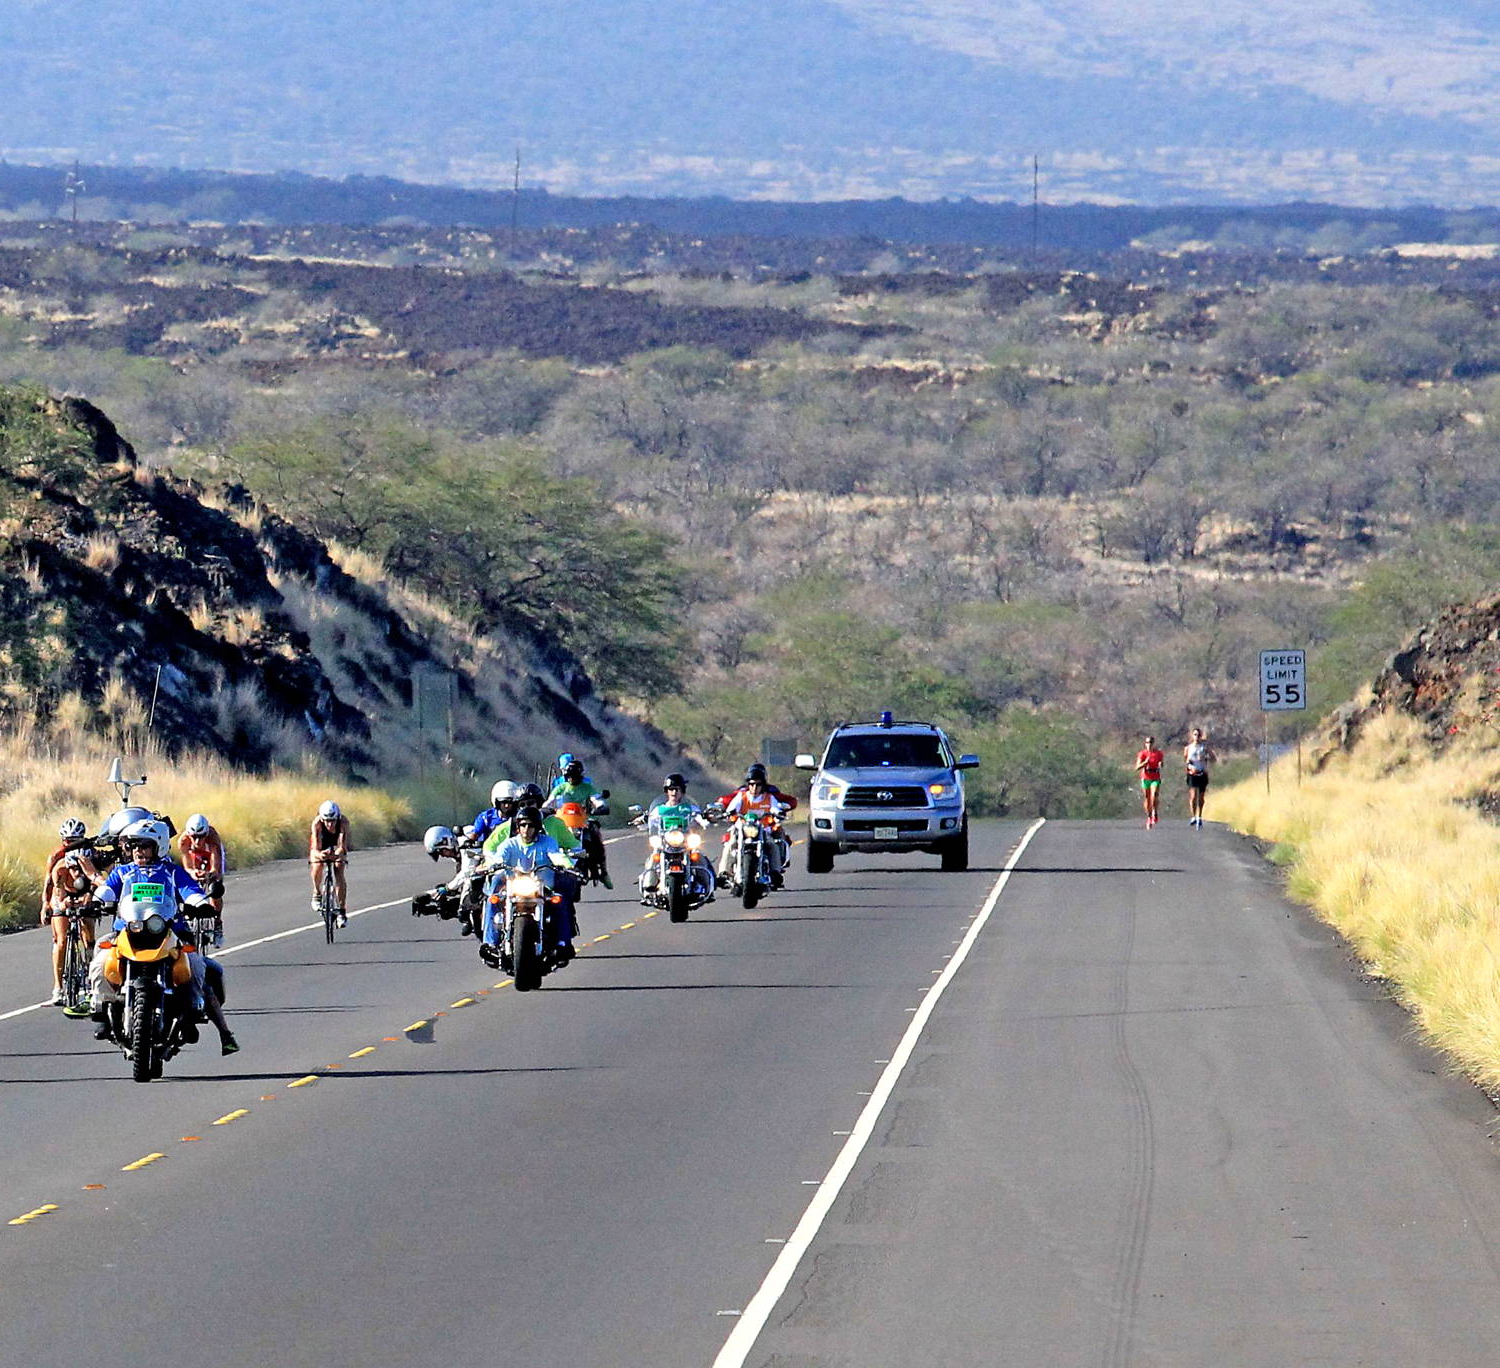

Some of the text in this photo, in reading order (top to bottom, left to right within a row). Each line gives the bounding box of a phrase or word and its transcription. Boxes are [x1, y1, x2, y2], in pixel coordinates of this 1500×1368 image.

[1264, 655, 1302, 665] SPEED
[1267, 669, 1298, 680] LIMIT
[1266, 684, 1300, 703] 55
